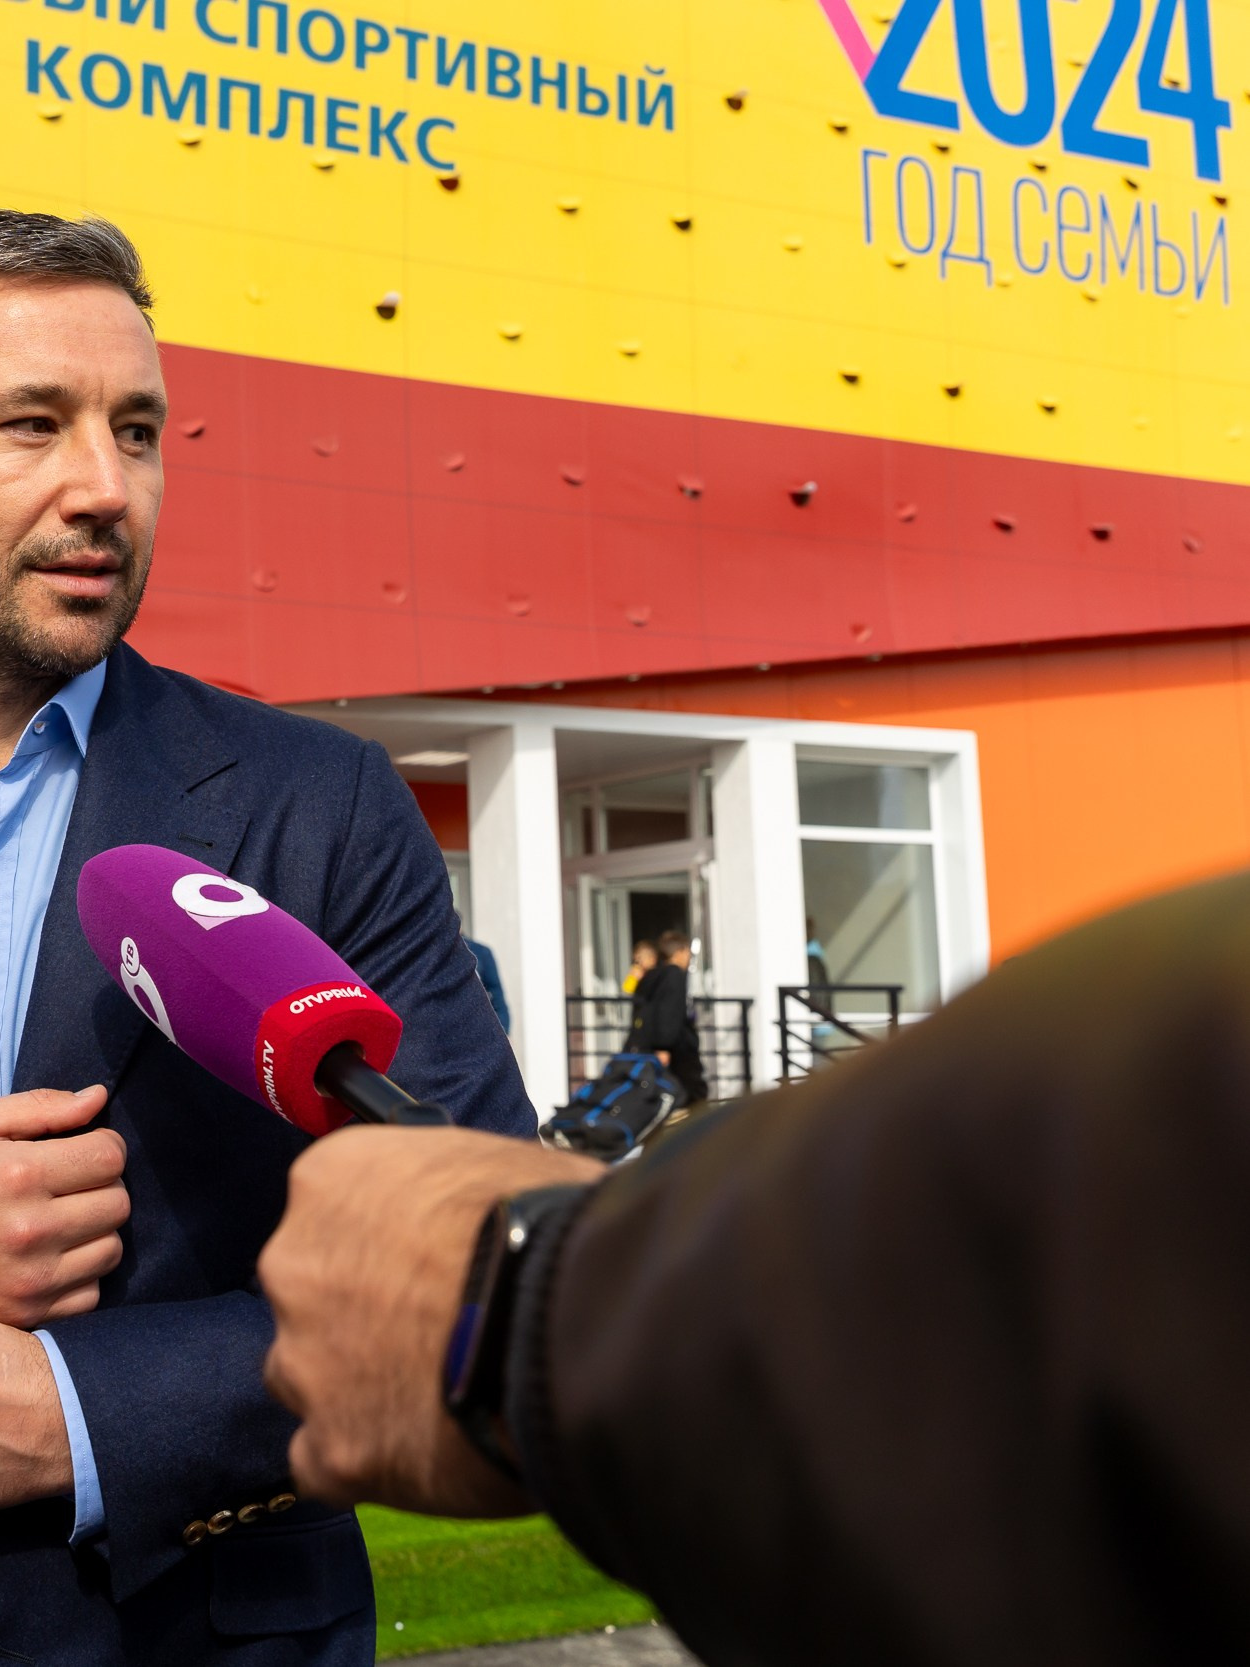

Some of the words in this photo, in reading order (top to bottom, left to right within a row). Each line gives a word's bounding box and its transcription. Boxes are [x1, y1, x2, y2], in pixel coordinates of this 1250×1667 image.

[25, 39, 456, 171] КОМПЛЕКС
[193, 0, 676, 132] СПОРТИВНЫЙ
[862, 0, 1232, 183] 2024
[861, 148, 993, 288] ГОД
